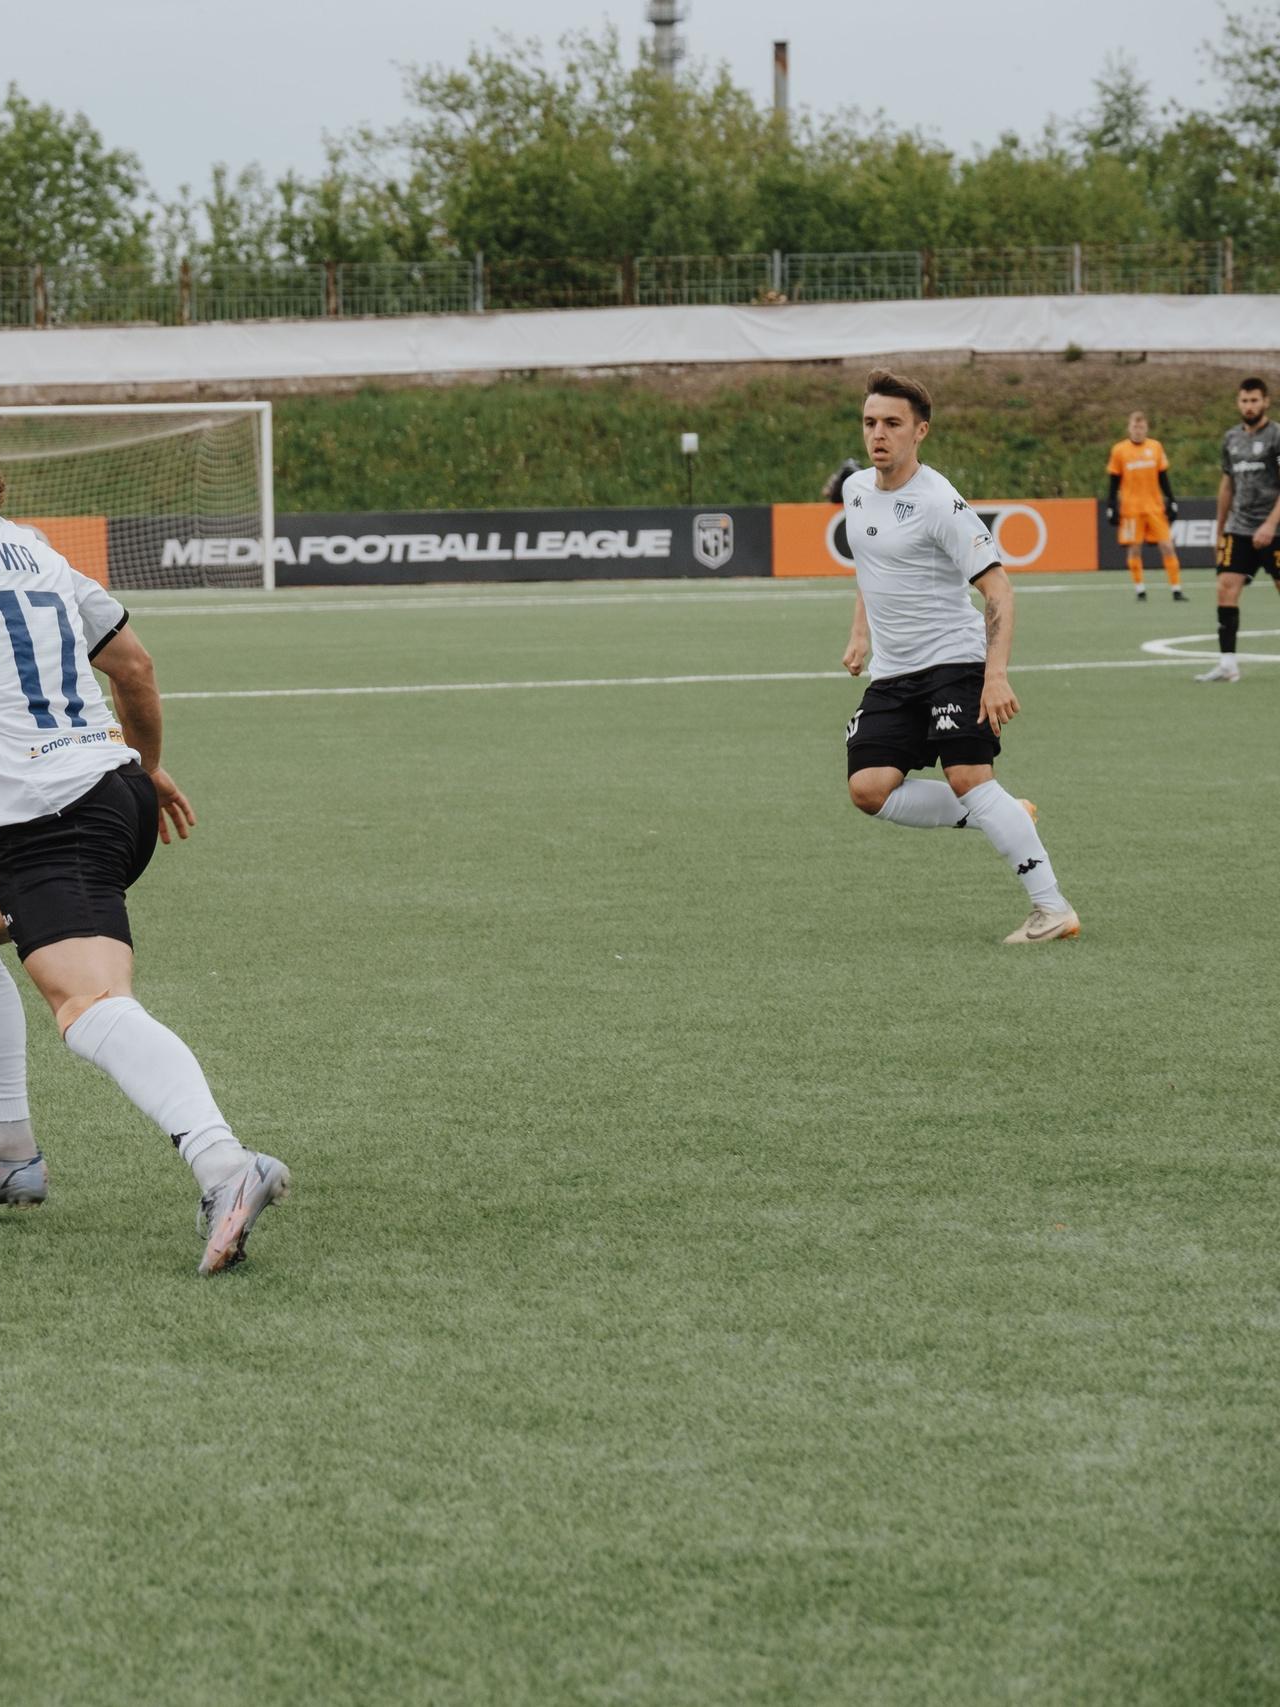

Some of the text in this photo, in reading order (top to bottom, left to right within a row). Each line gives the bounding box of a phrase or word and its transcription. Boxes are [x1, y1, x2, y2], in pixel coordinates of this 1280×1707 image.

[161, 529, 672, 567] MEDA FOOTBALL LEAGUE
[109, 730, 124, 741] PR
